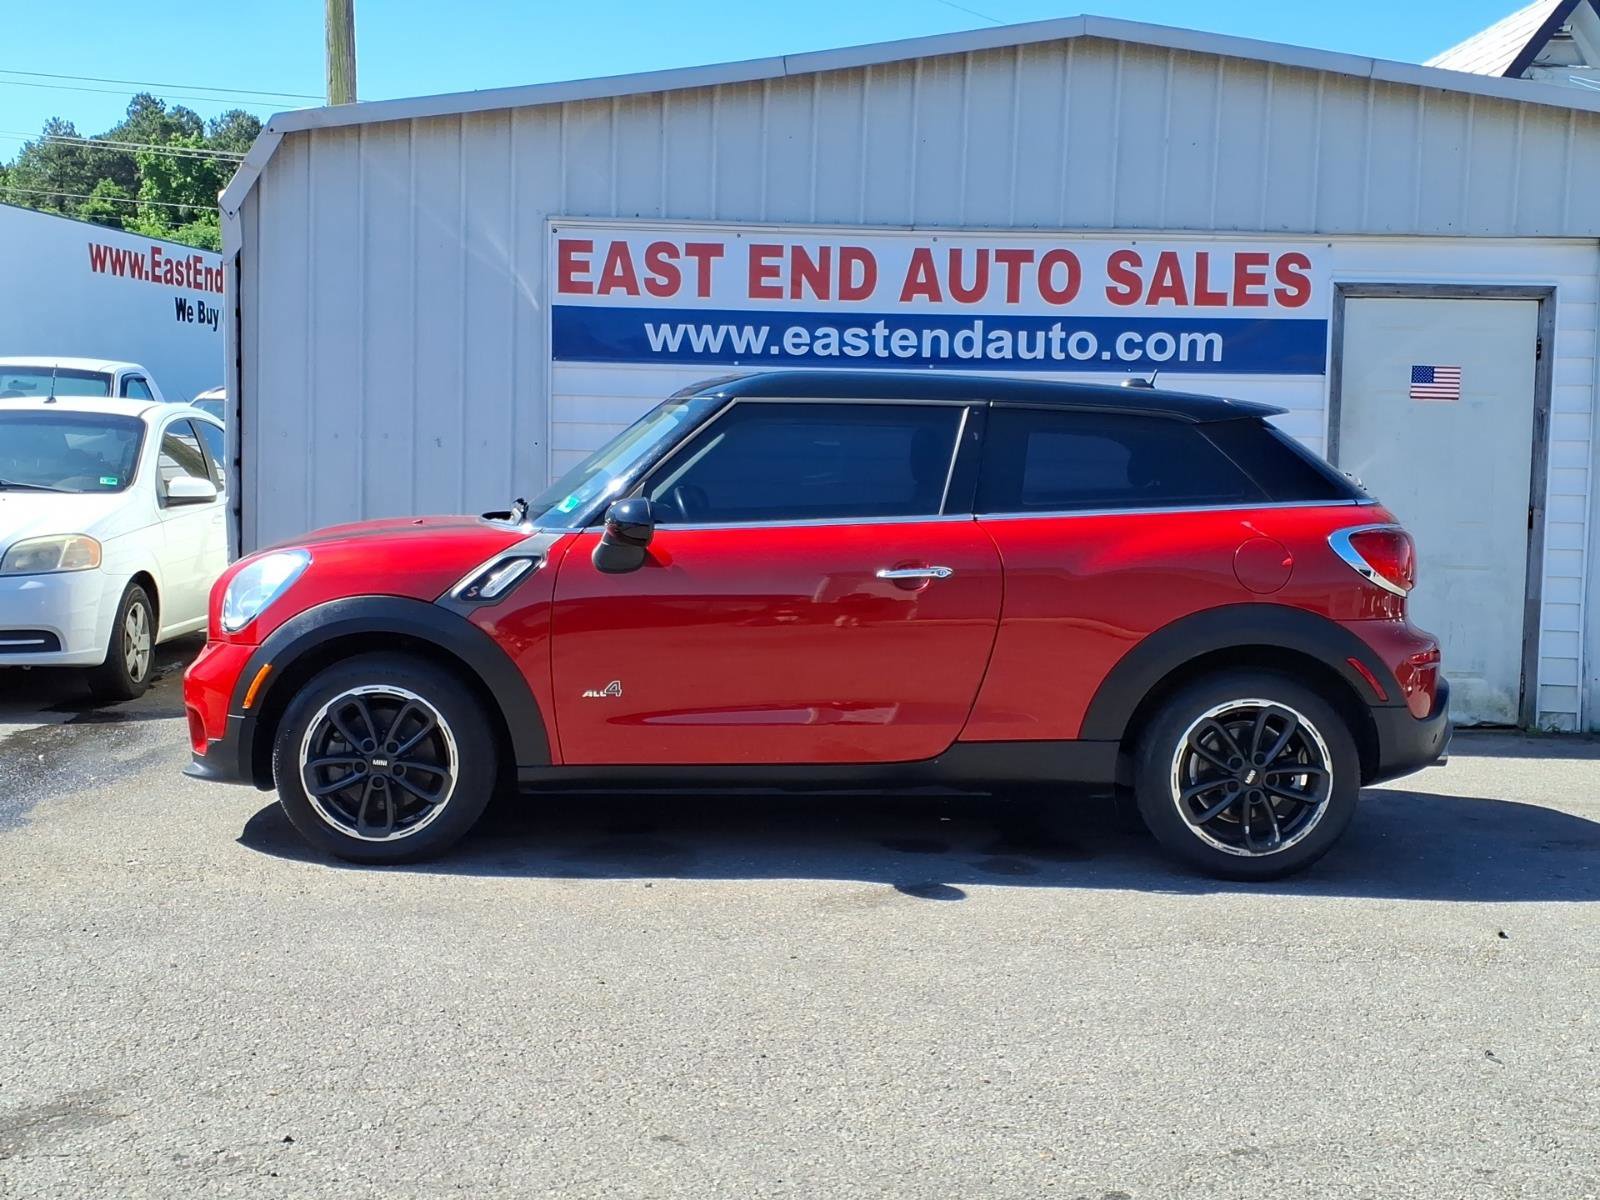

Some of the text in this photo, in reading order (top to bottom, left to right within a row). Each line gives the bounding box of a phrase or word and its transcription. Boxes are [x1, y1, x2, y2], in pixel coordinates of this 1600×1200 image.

[557, 239, 1312, 308] EAST END AUTO SALES
[175, 297, 219, 332] We Buy
[644, 319, 1223, 363] www.eastendauto.com
[467, 586, 478, 597] S
